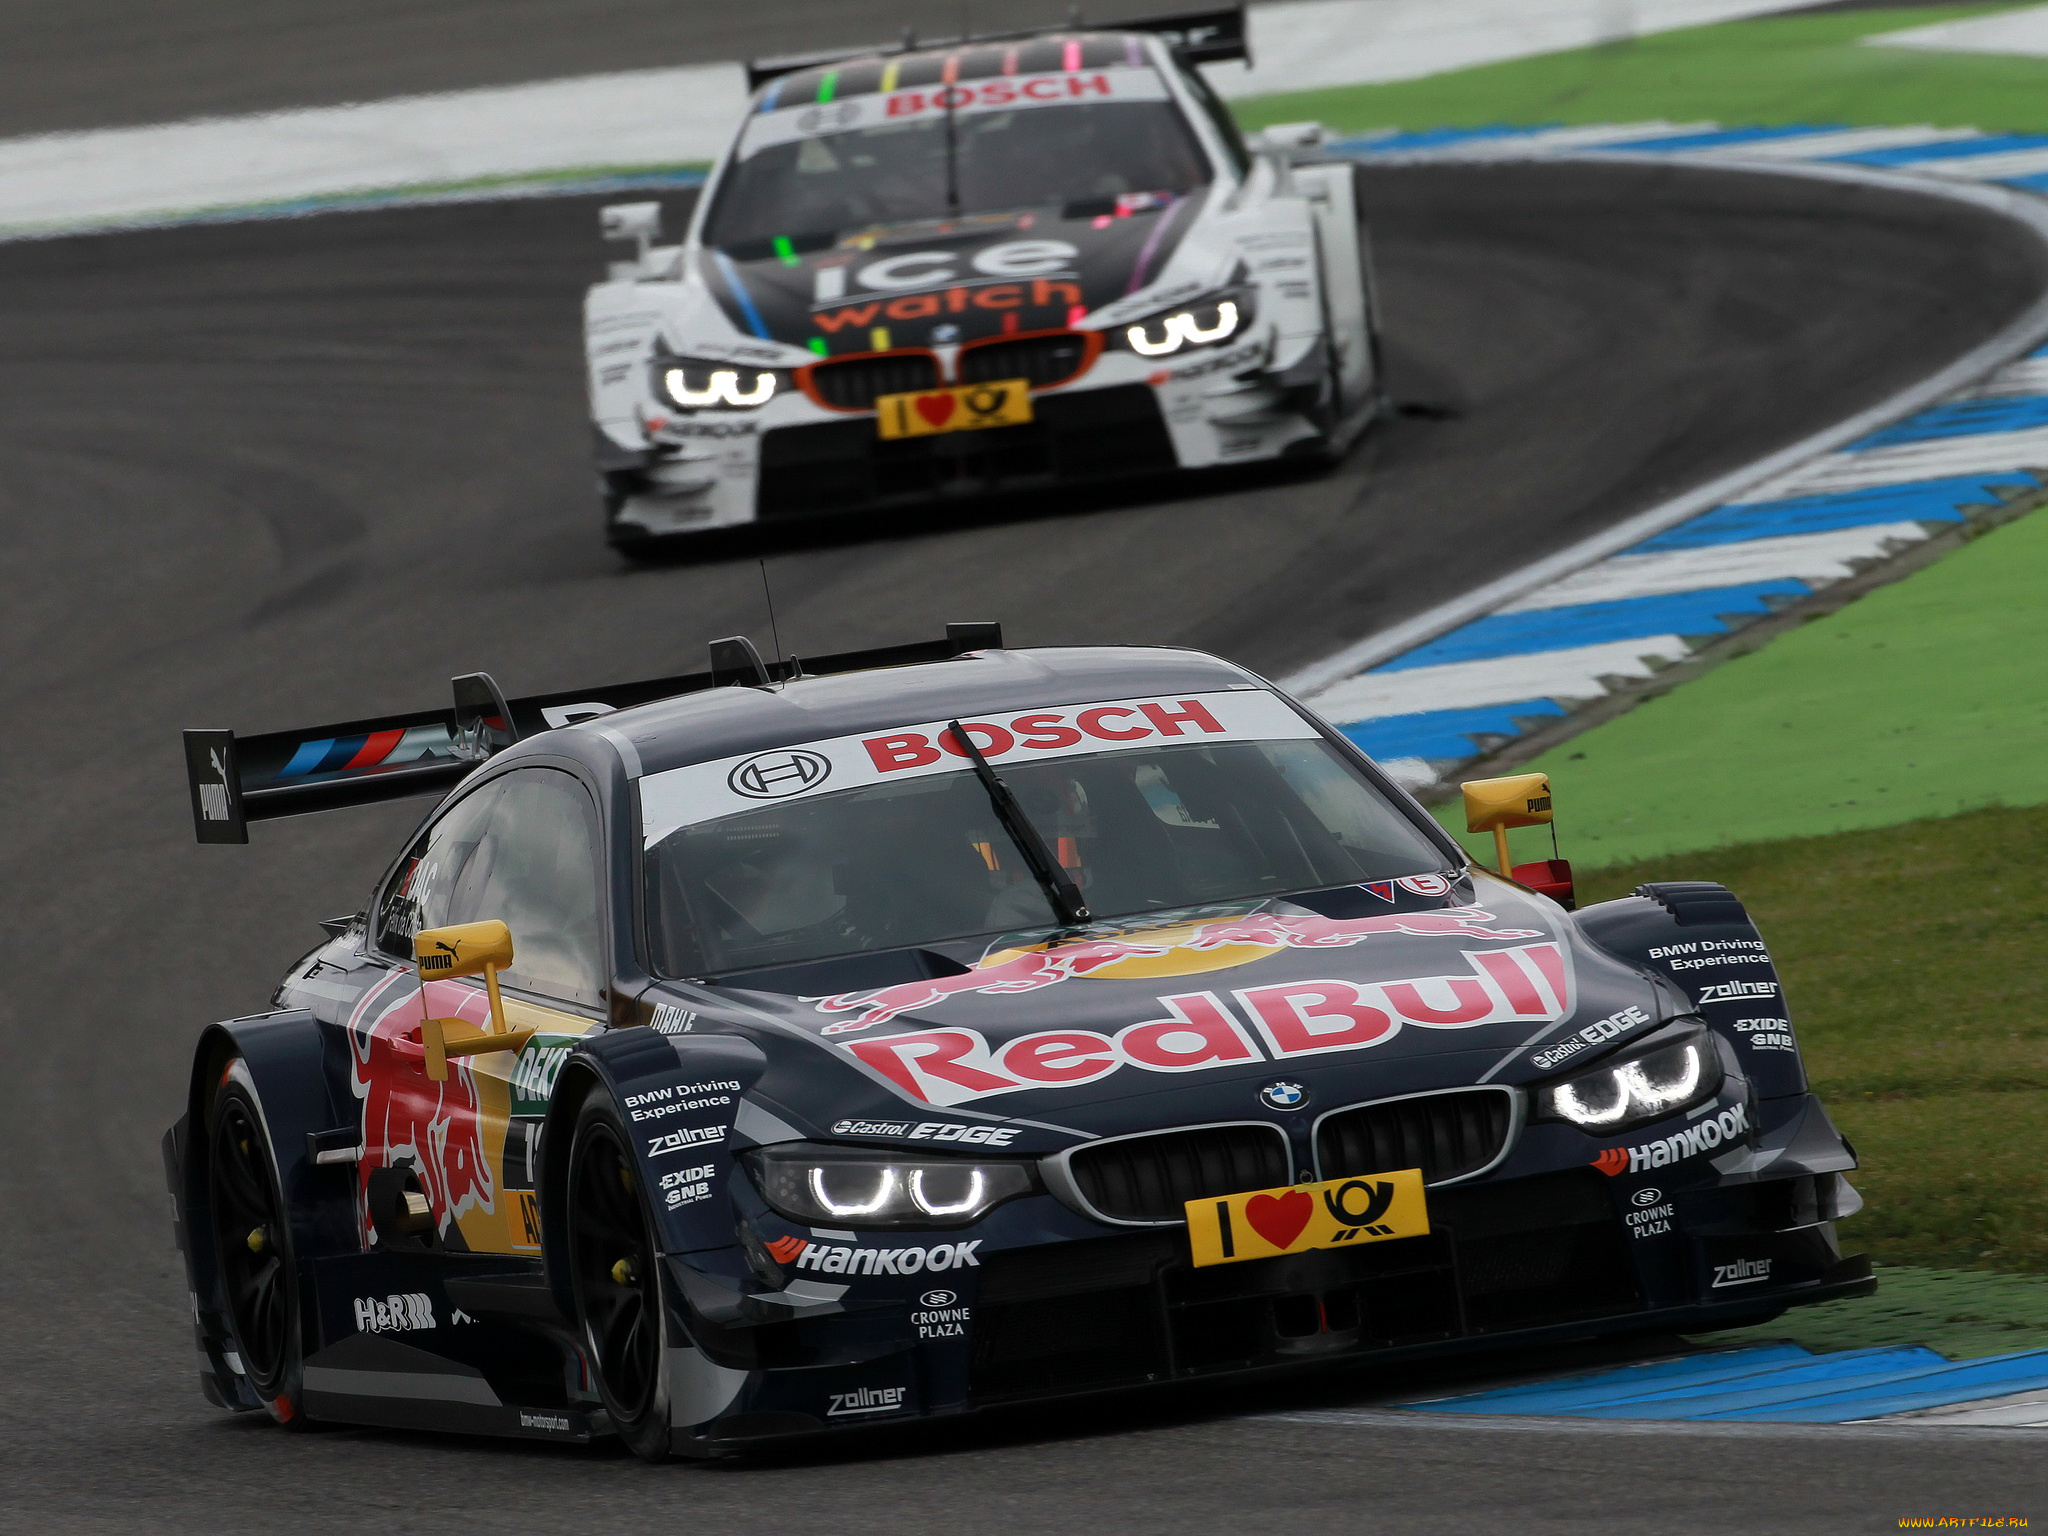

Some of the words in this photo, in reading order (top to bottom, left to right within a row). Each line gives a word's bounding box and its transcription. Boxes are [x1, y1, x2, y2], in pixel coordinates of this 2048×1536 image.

[885, 74, 1111, 118] BOSCH
[814, 239, 1079, 302] ice
[812, 278, 1082, 332] watch
[861, 699, 1227, 773] BOSCH
[199, 783, 229, 821] PUMA
[1527, 796, 1551, 813] PUMA
[419, 954, 453, 970] PUMA
[1649, 943, 1697, 959] BMW
[1700, 939, 1766, 951] Driving
[1670, 953, 1770, 970] Experience
[1579, 1006, 1650, 1046] EDGE
[1733, 1018, 1788, 1032] EXIDE
[1750, 1033, 1793, 1046] GNB
[625, 1088, 672, 1108] BMW
[676, 1080, 741, 1096] Driving
[631, 1095, 731, 1122] Experience
[849, 1121, 909, 1136] Castrol
[908, 1122, 1023, 1147] EDGE
[524, 1121, 545, 1183] 1
[659, 1164, 715, 1190] EXIDE
[665, 1182, 710, 1204] GNB
[1625, 1203, 1675, 1226] CROWNE
[1216, 1201, 1235, 1258] I
[1633, 1219, 1671, 1239] PLAZA
[354, 1293, 413, 1333] H&R
[911, 1308, 970, 1325] CROWNE
[919, 1323, 964, 1339] PLAZA
